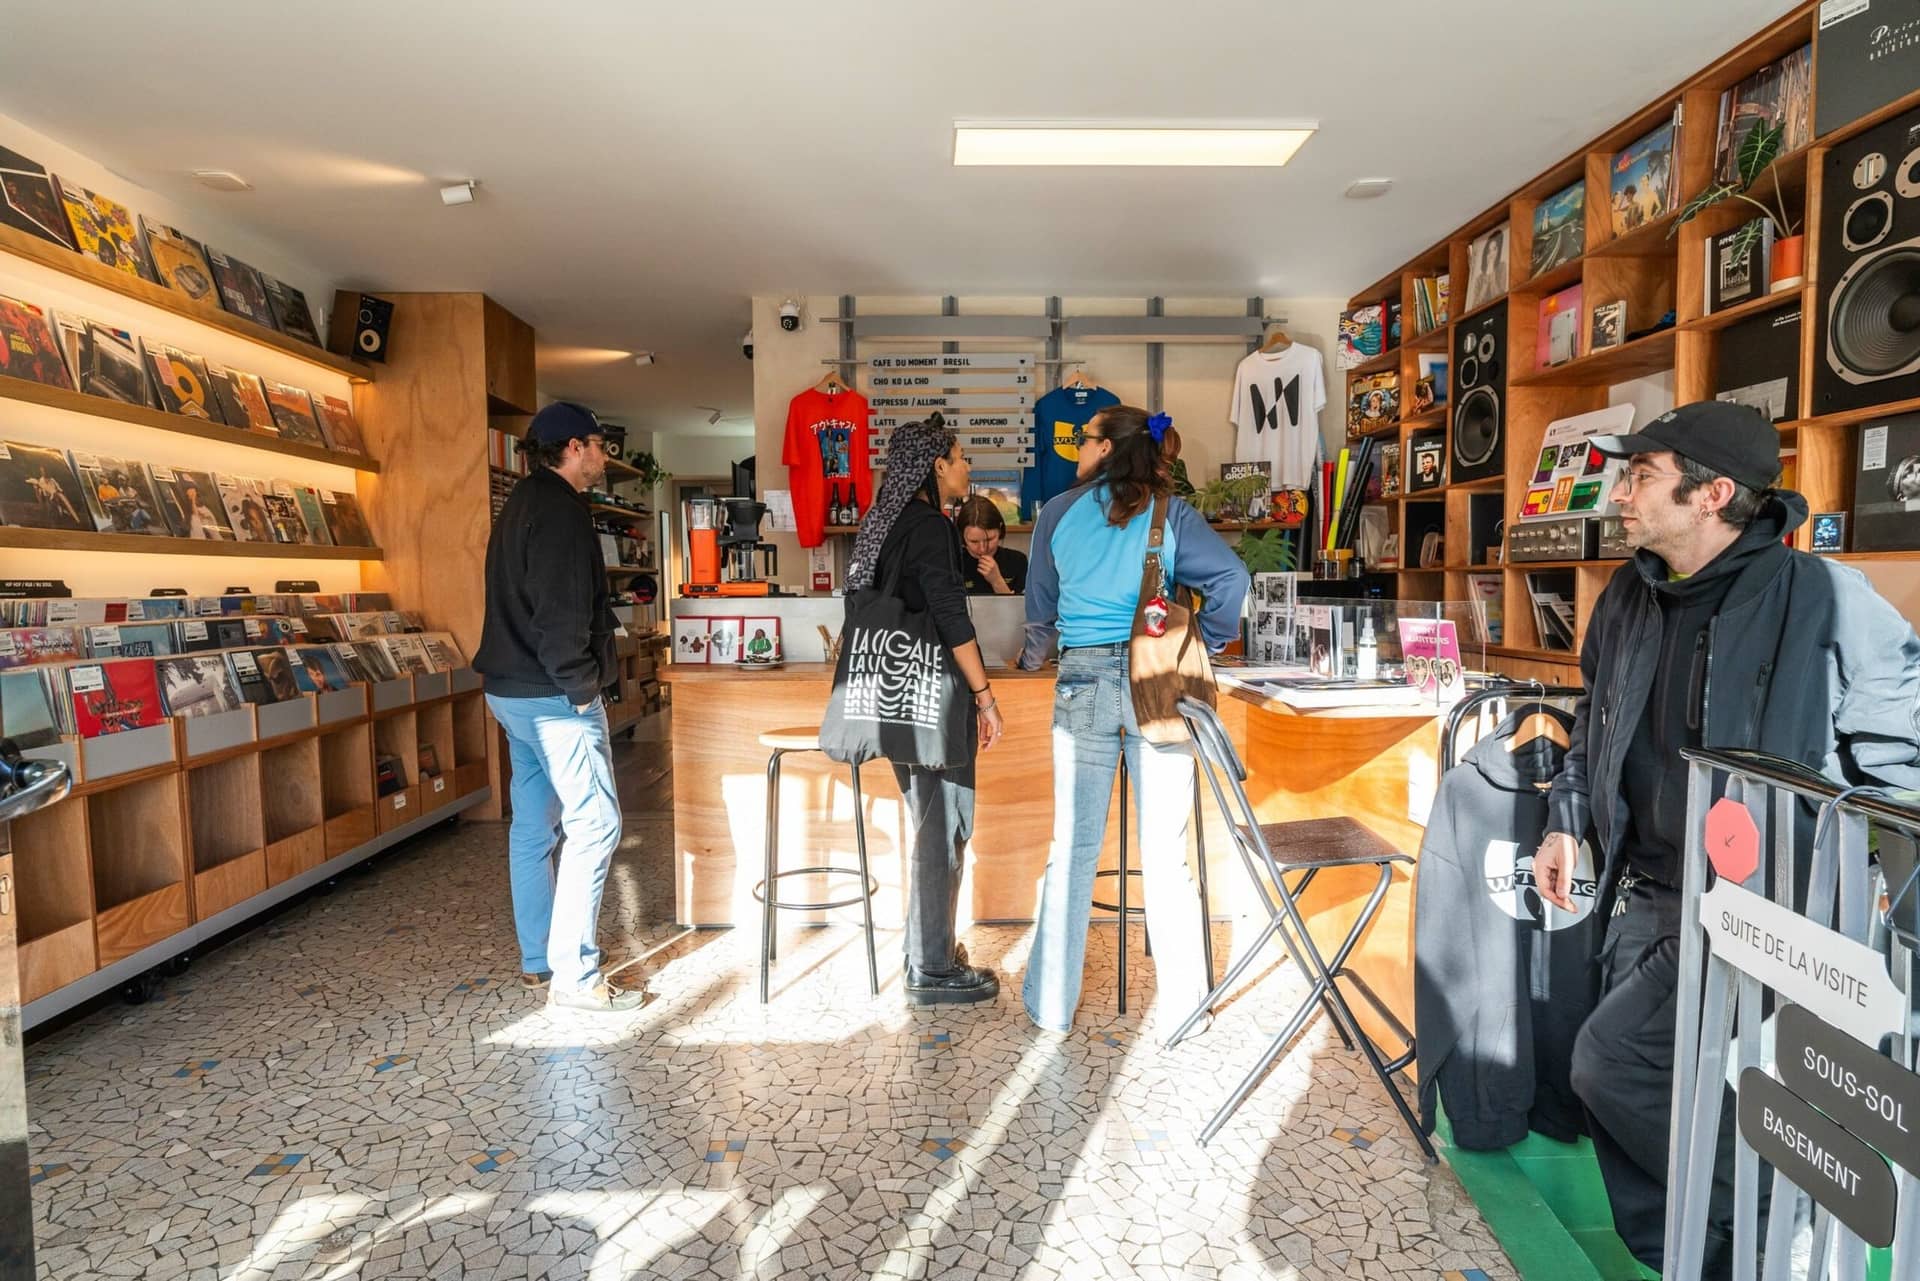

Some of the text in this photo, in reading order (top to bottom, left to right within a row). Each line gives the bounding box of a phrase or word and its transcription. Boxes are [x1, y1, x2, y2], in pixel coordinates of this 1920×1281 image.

[873, 358, 971, 367] CAFE DU MOMENT BRESIL
[873, 377, 889, 386] CHO
[914, 377, 930, 385] CHO
[872, 398, 909, 407] ESPRESSO
[874, 418, 897, 427] LATTE
[970, 437, 992, 445] BIERE
[851, 628, 869, 654] LA
[1721, 911, 1868, 1008] SUITE DE LA VISITE
[1803, 1046, 1909, 1133] SOUS-SOL
[1763, 1106, 1861, 1197] BASEMENT
